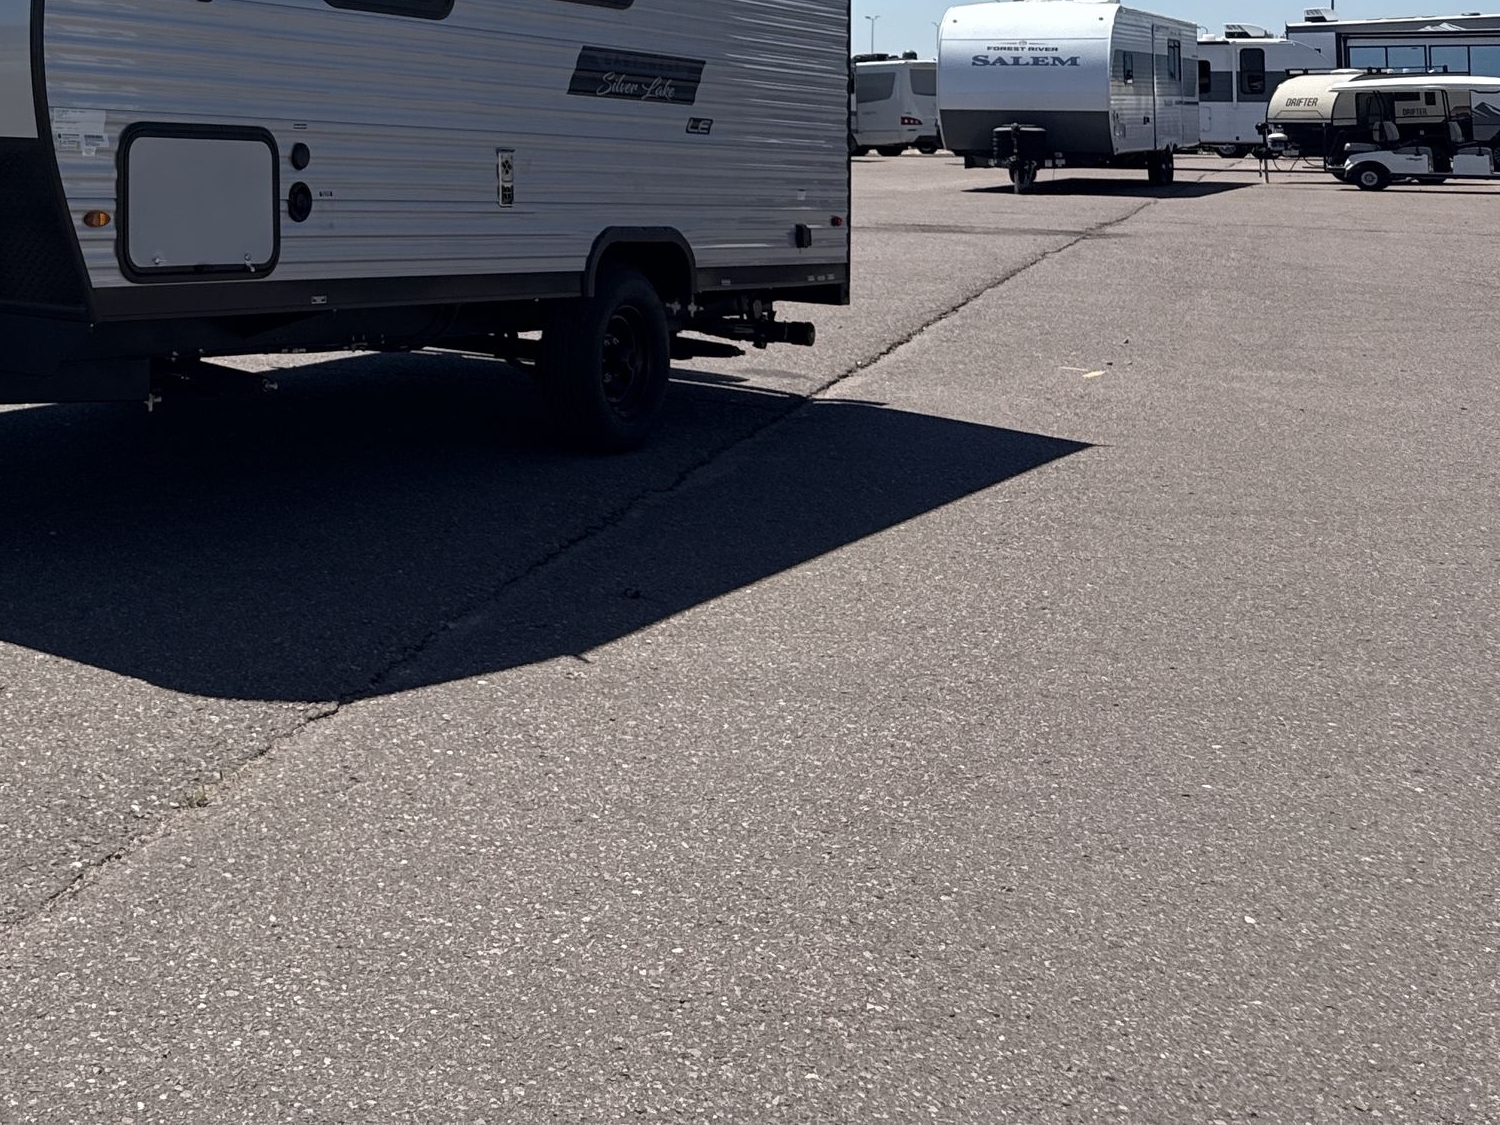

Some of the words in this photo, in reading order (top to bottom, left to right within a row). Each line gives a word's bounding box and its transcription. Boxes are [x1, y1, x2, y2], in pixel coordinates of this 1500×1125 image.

[971, 55, 1081, 67] SALEM
[596, 71, 639, 96] Silver
[641, 75, 676, 101] Lake
[1285, 97, 1319, 107] DRIFTER
[1402, 107, 1428, 116] DRIFTER
